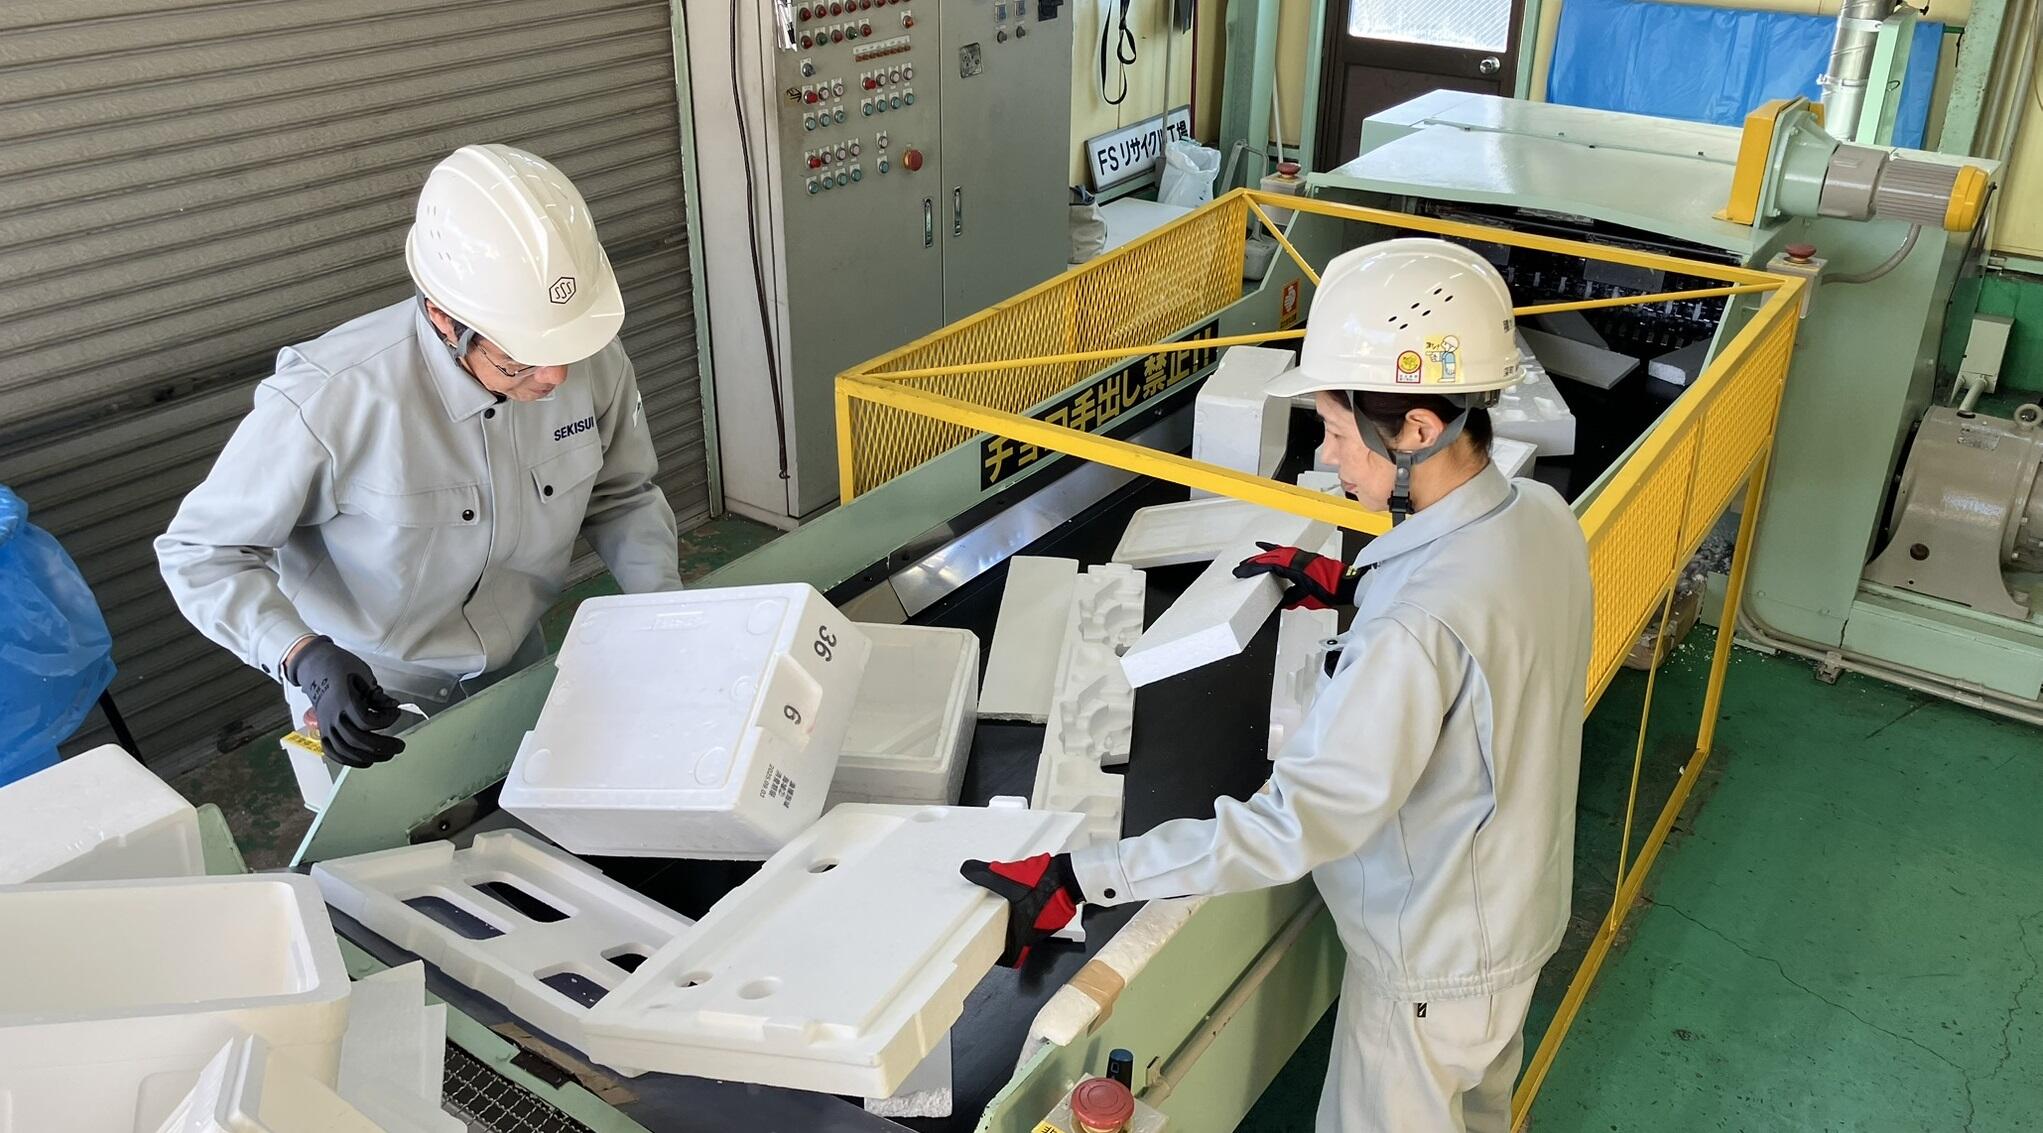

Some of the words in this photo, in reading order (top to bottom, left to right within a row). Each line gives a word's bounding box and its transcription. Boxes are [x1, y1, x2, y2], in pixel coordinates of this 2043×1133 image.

[554, 416, 595, 441] SEKISUI
[814, 625, 837, 662] 36
[784, 705, 801, 725] 6
